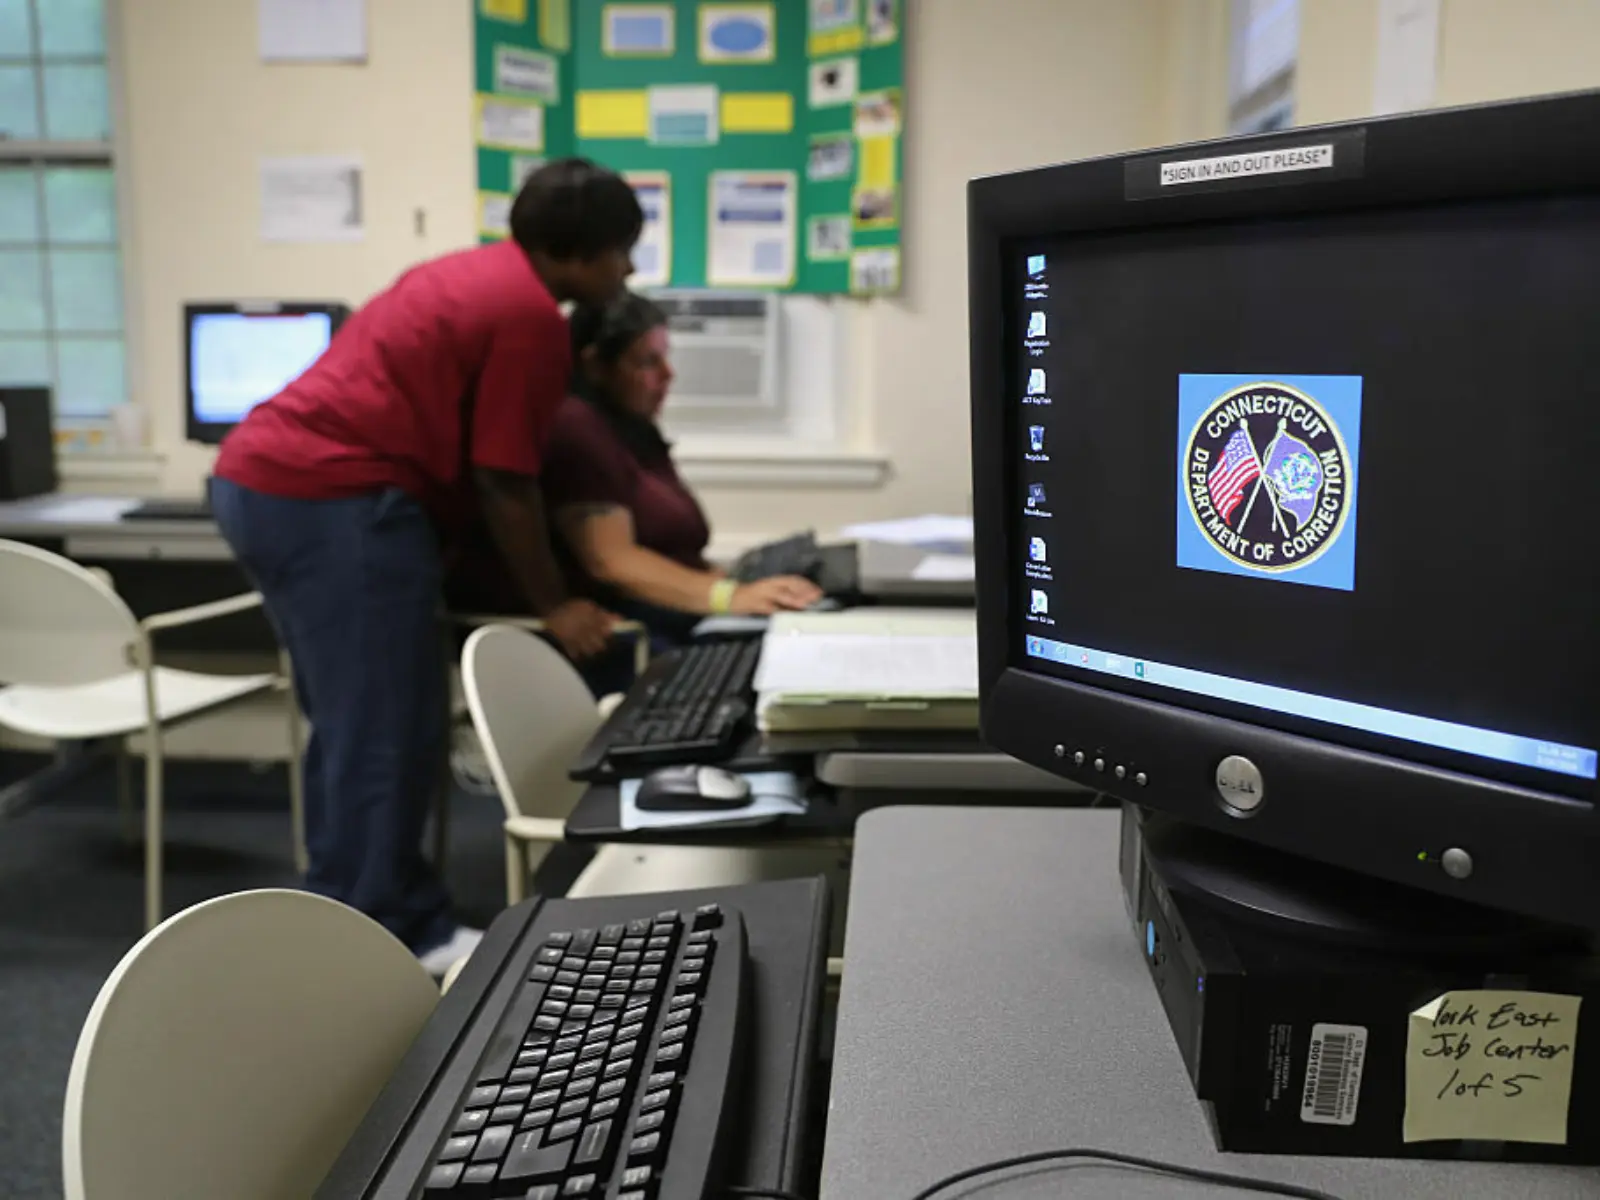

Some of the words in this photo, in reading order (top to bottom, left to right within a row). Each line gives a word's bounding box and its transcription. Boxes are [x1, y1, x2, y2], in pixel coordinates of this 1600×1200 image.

[1199, 163, 1211, 178] IN
[1214, 159, 1241, 176] AND
[1243, 156, 1271, 172] OUT
[1206, 394, 1328, 439] CONNECTICUT
[1190, 446, 1250, 557] DEPARTMENT
[1252, 543, 1275, 561] OF
[1281, 448, 1343, 559] CORRECTION
[1486, 1002, 1561, 1030] East
[1422, 1032, 1471, 1060] Job
[1484, 1036, 1570, 1060] Center
[1502, 1074, 1542, 1097] 5
